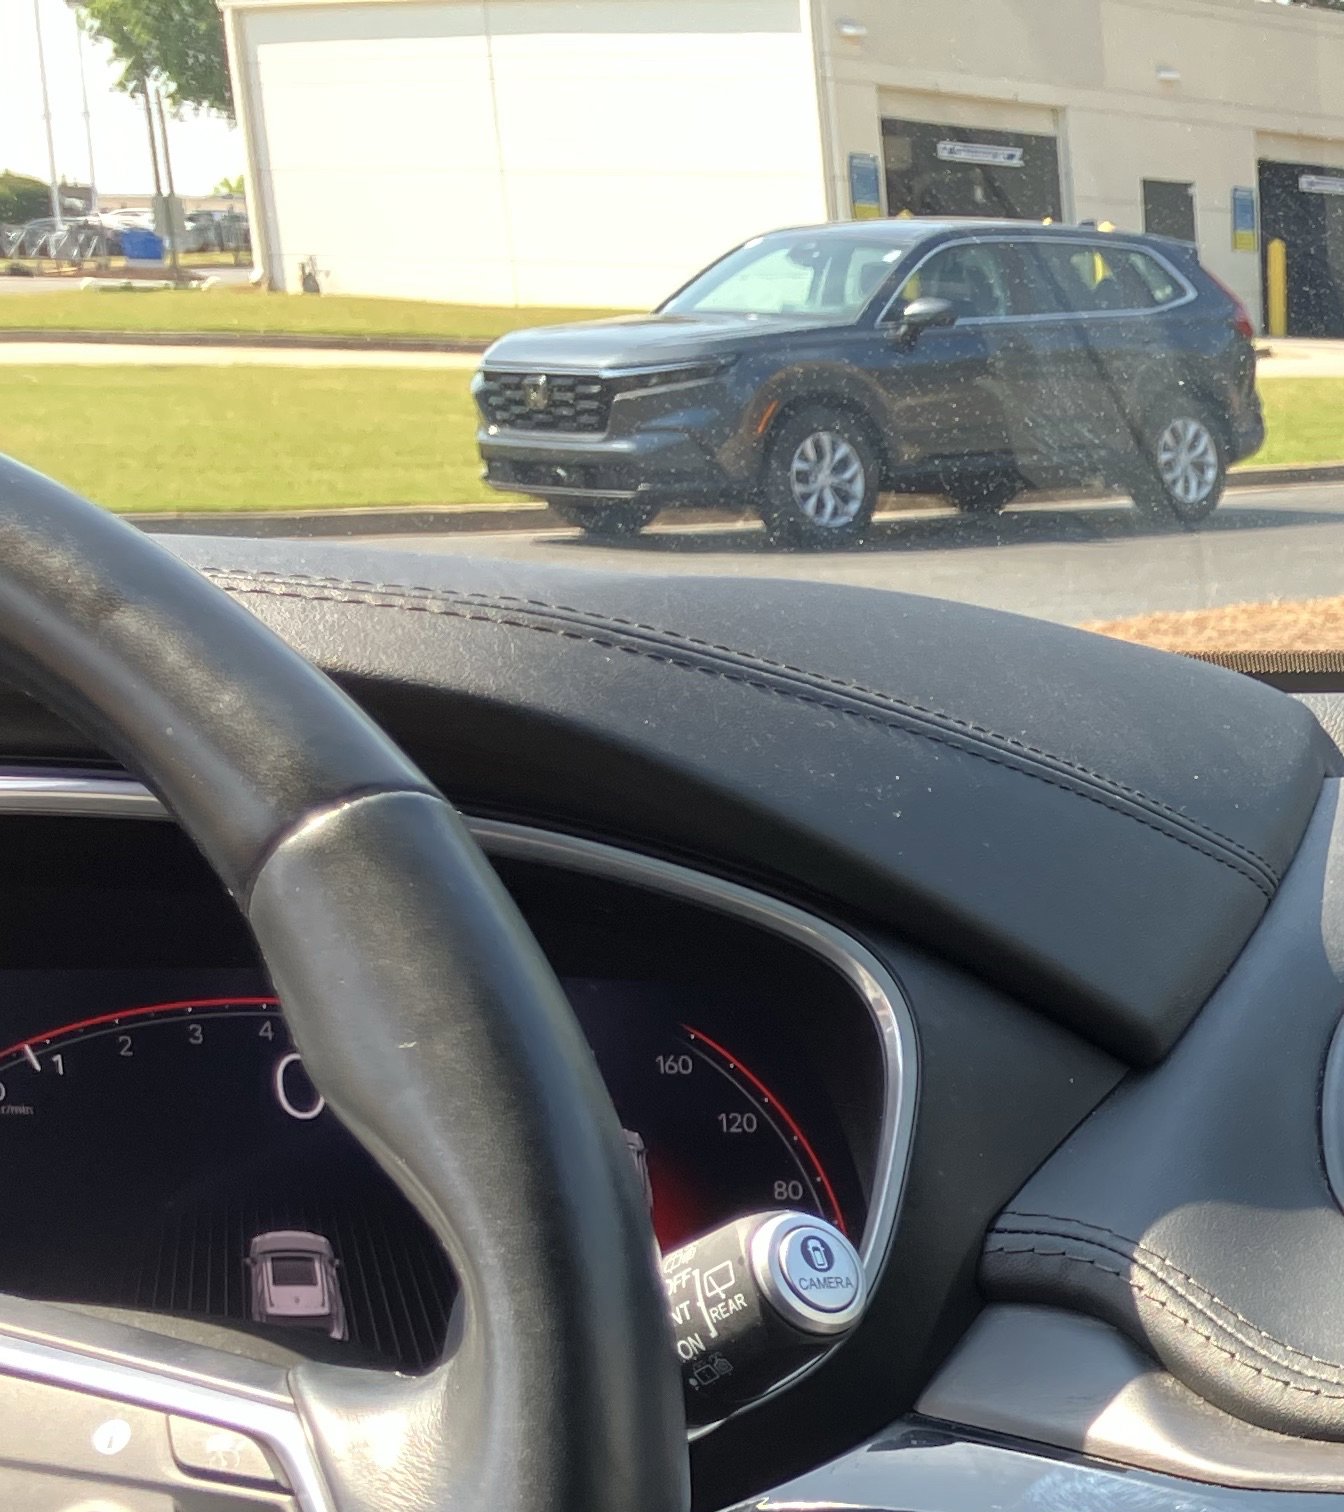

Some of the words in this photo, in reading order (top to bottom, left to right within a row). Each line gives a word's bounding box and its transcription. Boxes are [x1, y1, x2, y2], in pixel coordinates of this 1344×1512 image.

[188, 1024, 204, 1045] 3
[259, 1020, 275, 1042] 4
[119, 1036, 134, 1057] 2
[52, 1054, 63, 1075] 1
[655, 1054, 694, 1076] 160
[718, 1112, 758, 1134] 120
[773, 1180, 804, 1201] 80
[799, 1275, 855, 1291] CAMERA
[709, 1293, 748, 1323] REAR
[676, 1332, 707, 1361] ON
